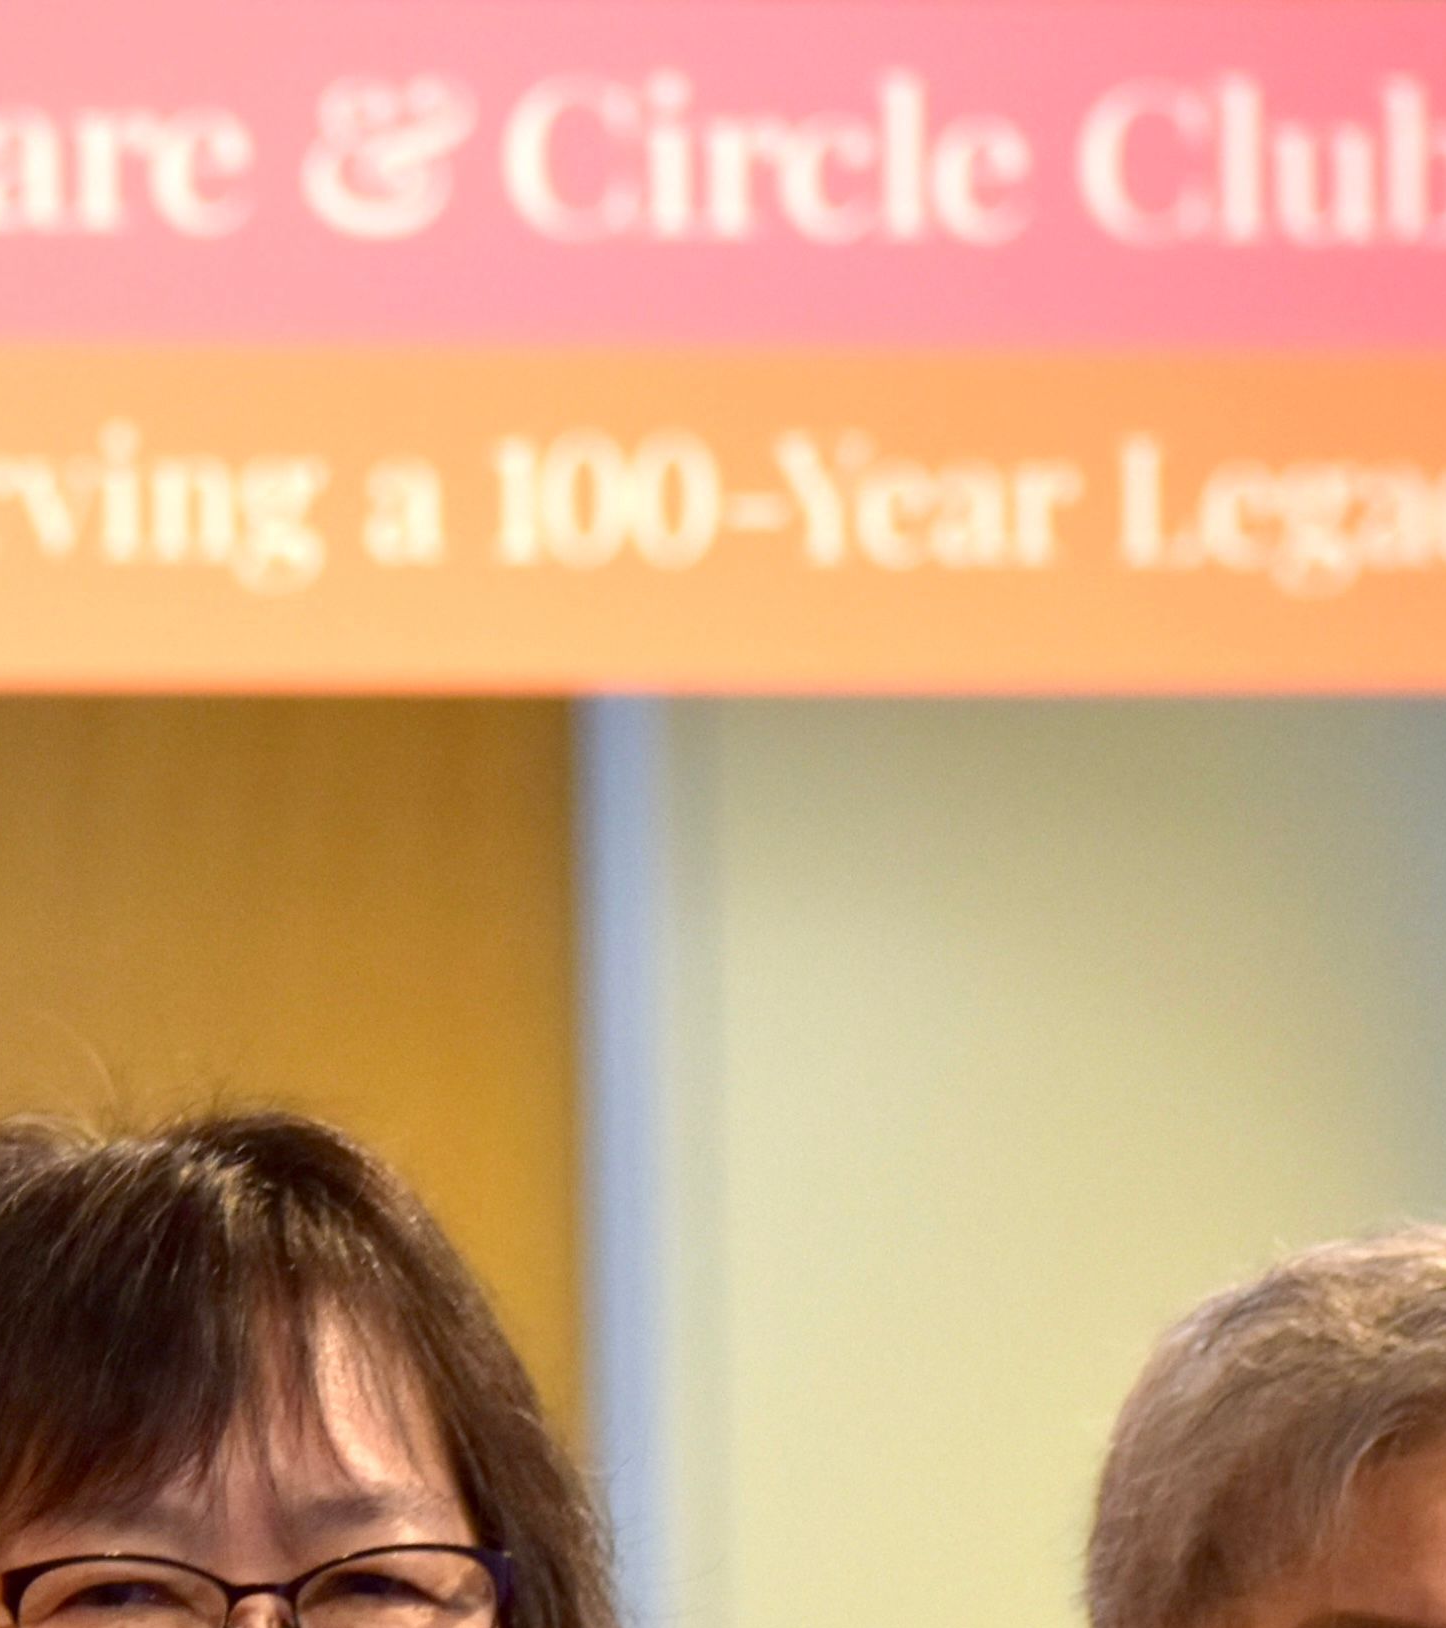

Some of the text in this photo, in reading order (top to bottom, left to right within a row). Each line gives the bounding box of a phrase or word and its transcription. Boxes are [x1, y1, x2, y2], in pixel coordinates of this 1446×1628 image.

[300, 70, 479, 242] &
[500, 68, 1035, 247] Circle
[361, 454, 443, 568] a
[492, 425, 1084, 571] 100-Year
